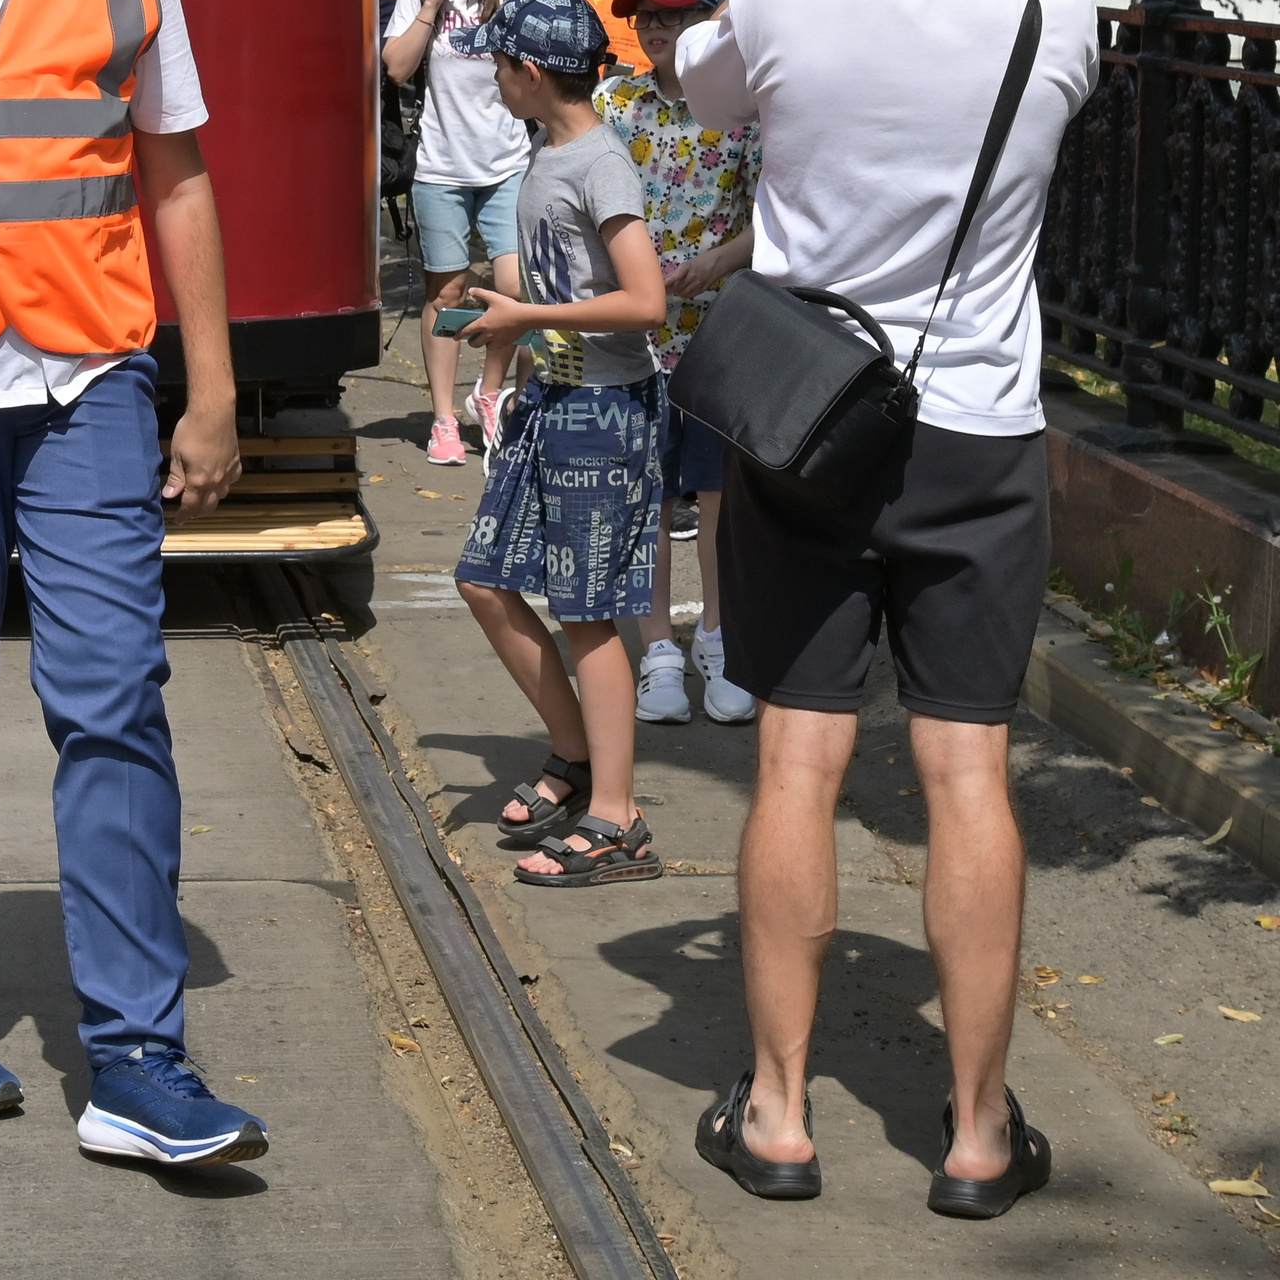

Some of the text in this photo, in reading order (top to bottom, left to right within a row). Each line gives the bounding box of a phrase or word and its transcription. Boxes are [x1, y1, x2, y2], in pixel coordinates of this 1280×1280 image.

[543, 467, 600, 488] YACHT
[514, 502, 541, 564] SAILING
[501, 544, 515, 577] WORLD
[546, 543, 575, 578] 68
[585, 511, 601, 607] ROUND THE WORLD
[596, 525, 613, 591] SAILING
